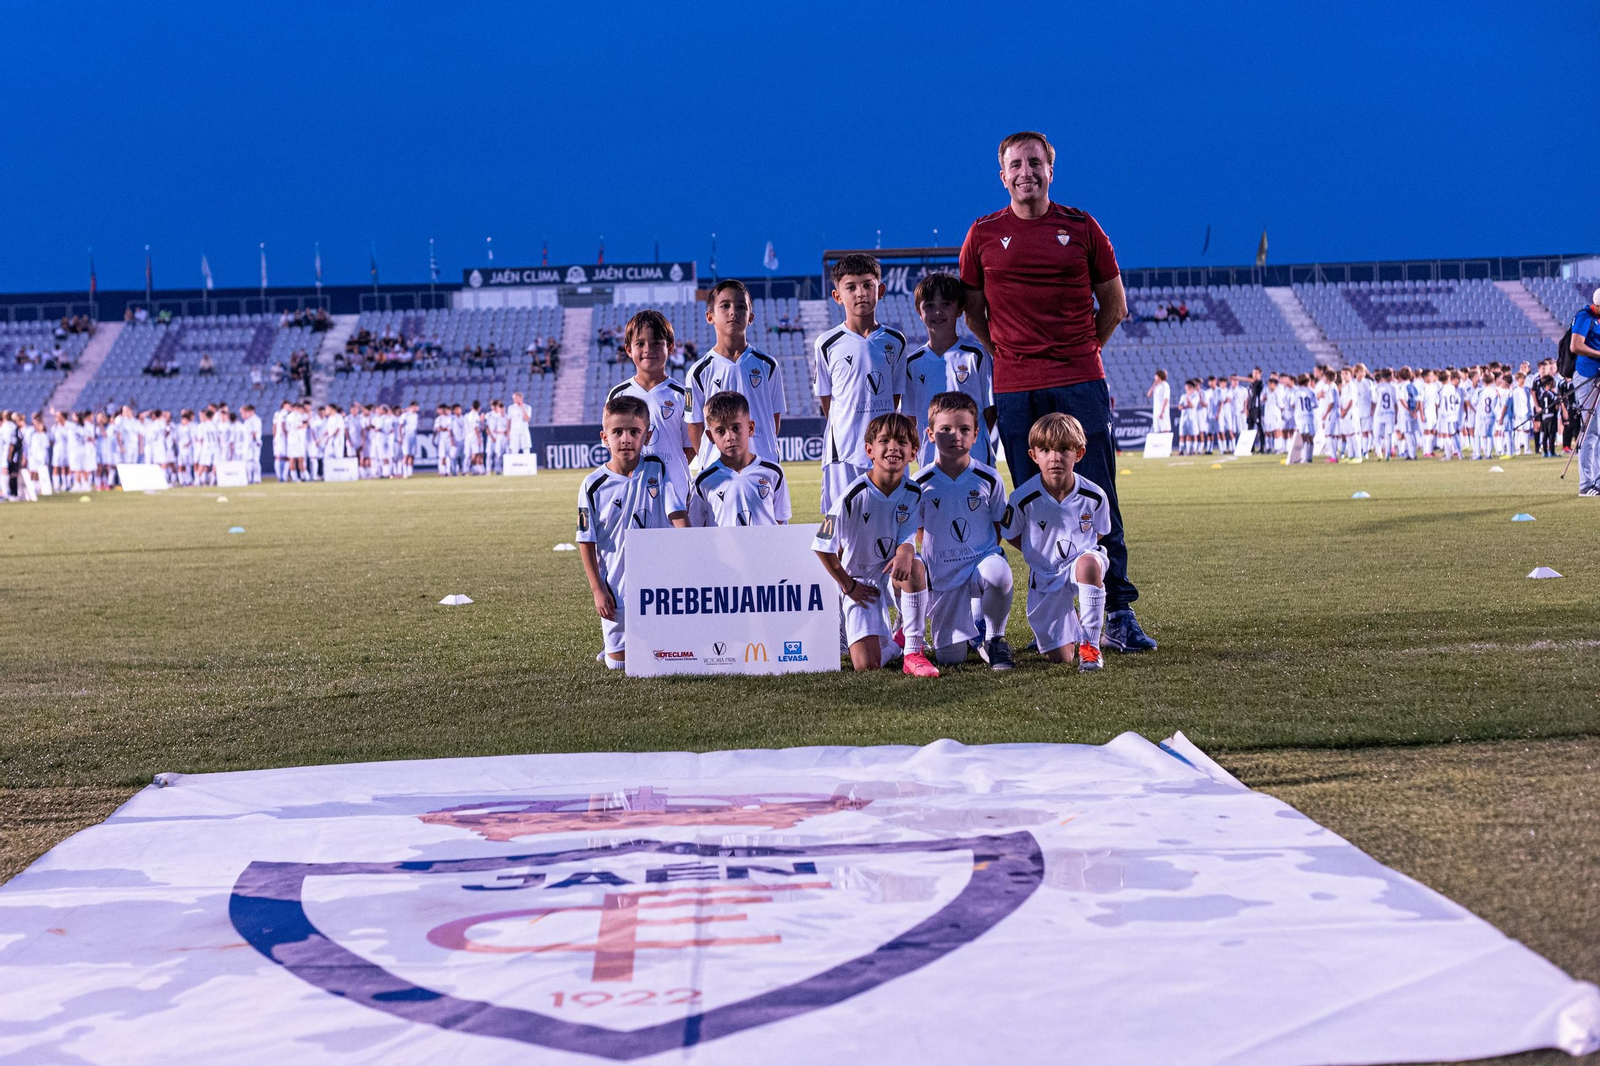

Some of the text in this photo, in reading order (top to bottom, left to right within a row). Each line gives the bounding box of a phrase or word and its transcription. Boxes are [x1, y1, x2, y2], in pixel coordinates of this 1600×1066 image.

[489, 268, 560, 285] JAÉN CLIMA
[592, 265, 663, 280] JAÉN CLIMA
[1300, 396, 1312, 411] 10
[1382, 393, 1391, 409] 9
[1484, 397, 1492, 413] 8
[640, 579, 824, 616] PREBENJAMÍN A
[550, 987, 704, 1009] 1922
